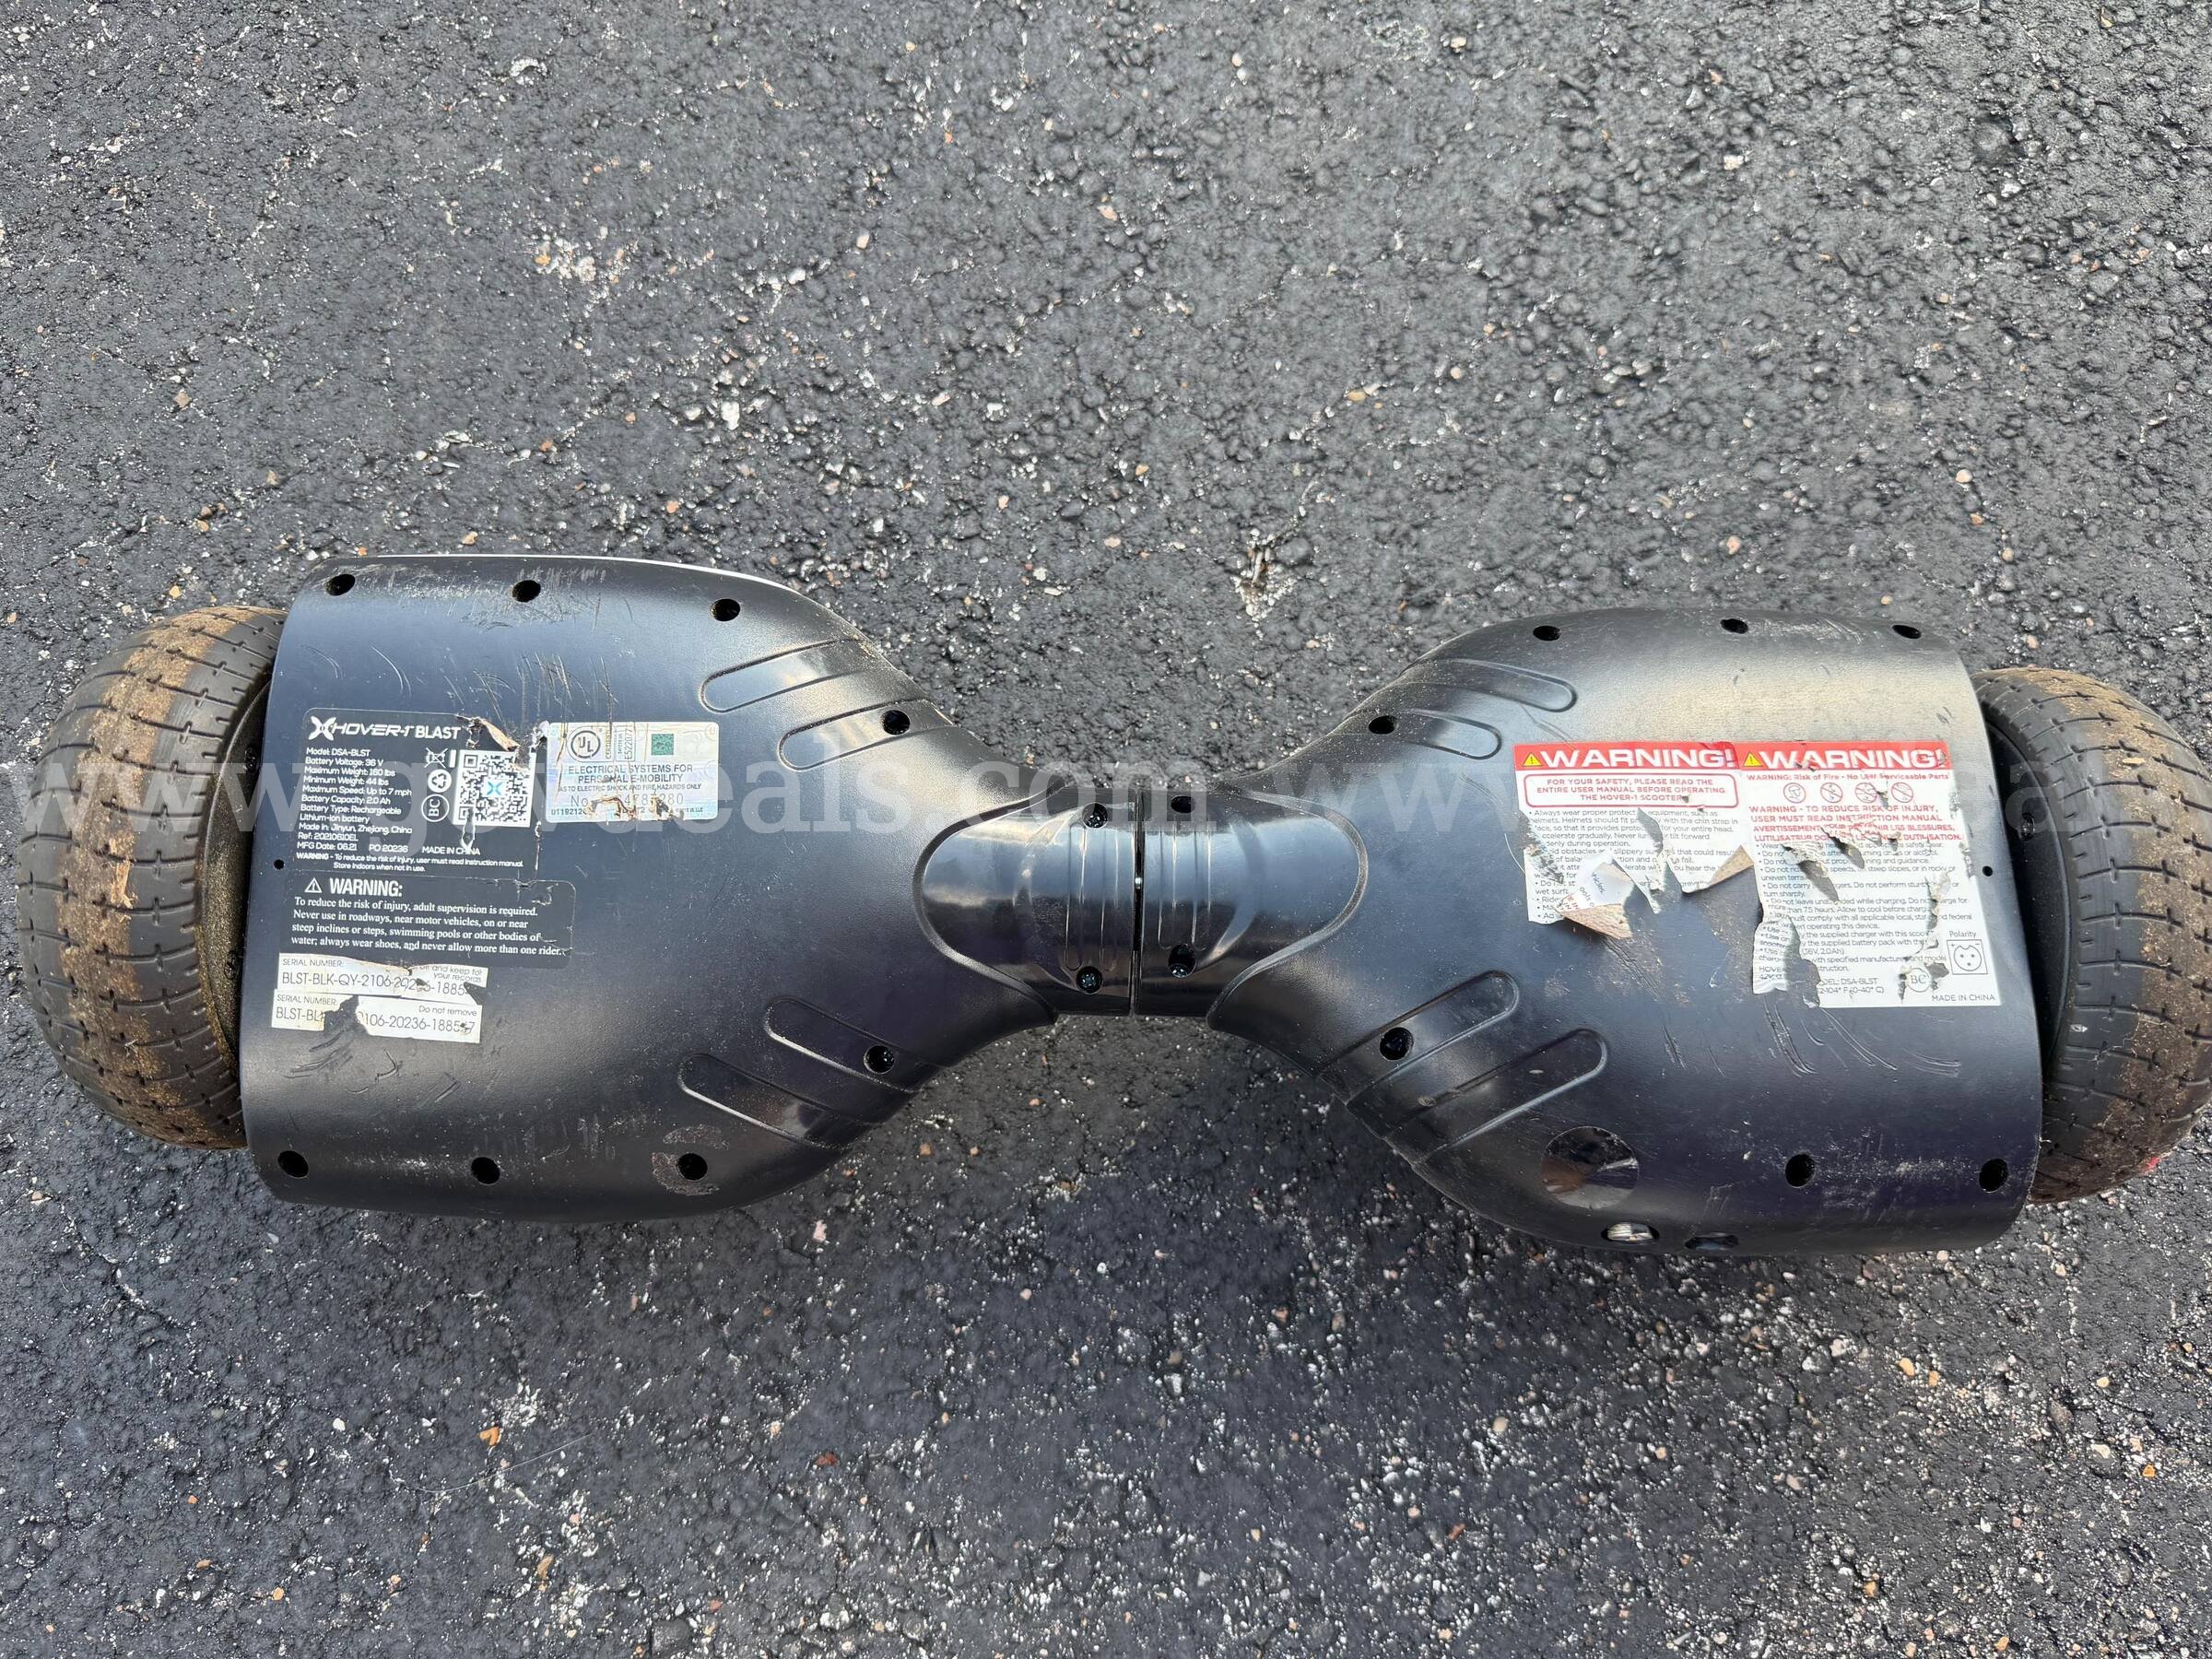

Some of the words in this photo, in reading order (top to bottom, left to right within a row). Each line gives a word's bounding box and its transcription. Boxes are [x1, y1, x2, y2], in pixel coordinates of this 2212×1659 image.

[415, 725, 462, 739] BLAST
[331, 747, 371, 758] DSA-BLST
[304, 757, 332, 768] Battery
[334, 758, 363, 769] Voltage:
[376, 759, 384, 768] V
[1540, 748, 1735, 769] WARNING!
[1759, 748, 1947, 770] WARNING!
[304, 766, 339, 774] Maximum
[341, 768, 368, 777] Weight:
[569, 765, 626, 773] ELECTRICAL
[674, 764, 693, 772] FOR
[302, 775, 336, 783] Minimum
[337, 777, 364, 786] Weight:
[630, 774, 683, 782] E-MOBILITY
[1595, 778, 1632, 786] SAFETY,
[302, 784, 337, 794] Maximum
[338, 786, 365, 796] Speed:
[365, 788, 376, 797] Up
[394, 789, 411, 799] mph
[300, 794, 330, 805] Battery
[331, 795, 365, 806] Capacity:
[378, 797, 391, 806] Ah
[300, 803, 329, 814] Battery
[330, 805, 349, 815] Type:
[350, 806, 401, 817] Rechargeable
[1902, 805, 1938, 813] INJURY,
[299, 812, 340, 821] Lithium-ion
[341, 814, 369, 825] battery
[1751, 815, 1776, 823] USER
[299, 821, 320, 830] Made
[391, 826, 412, 834] China
[297, 840, 314, 849] MFG
[315, 841, 335, 850] Date:
[369, 843, 381, 852] PO
[382, 844, 407, 853] 20236
[422, 845, 446, 854] MADE
[455, 847, 481, 856] CHINA
[329, 877, 404, 898] WARNING:
[294, 896, 305, 906] To
[307, 897, 335, 907] reduce
[337, 898, 351, 908] the
[353, 899, 370, 909] risk
[371, 900, 382, 909] of
[383, 900, 411, 912] injury,
[413, 901, 435, 912] adult
[437, 902, 487, 916] supervision
[488, 905, 498, 914] is
[498, 905, 538, 919] required.
[292, 908, 319, 919] Never
[337, 911, 347, 920] in
[348, 911, 393, 924] roadways,
[394, 915, 413, 924] near
[415, 913, 441, 924] motor
[442, 915, 481, 928] vehicles,
[291, 922, 314, 935] steep
[315, 923, 350, 934] inclines
[362, 924, 387, 937] steps,
[389, 926, 433, 939] swimming
[437, 928, 461, 941] pools
[474, 930, 498, 940] other
[498, 931, 527, 942] bodies
[529, 933, 542, 942] of
[1819, 931, 1849, 939] supplied
[1948, 930, 1977, 938] Polarity
[319, 935, 350, 948] always
[374, 938, 402, 950] shoes,
[403, 939, 419, 949] and
[421, 943, 446, 951] never
[447, 942, 472, 952] allow
[499, 944, 518, 954] than
[538, 946, 562, 956] rider.
[282, 959, 307, 967] SERIAL
[433, 972, 451, 981] your
[450, 966, 468, 975] keep
[470, 968, 483, 976] for
[1911, 975, 1927, 984] BC
[276, 994, 301, 1004] SERIAL
[1969, 994, 1995, 1002] CHINA
[418, 1005, 431, 1013] Do
[432, 1006, 446, 1014] not
[447, 1008, 477, 1017] remove
